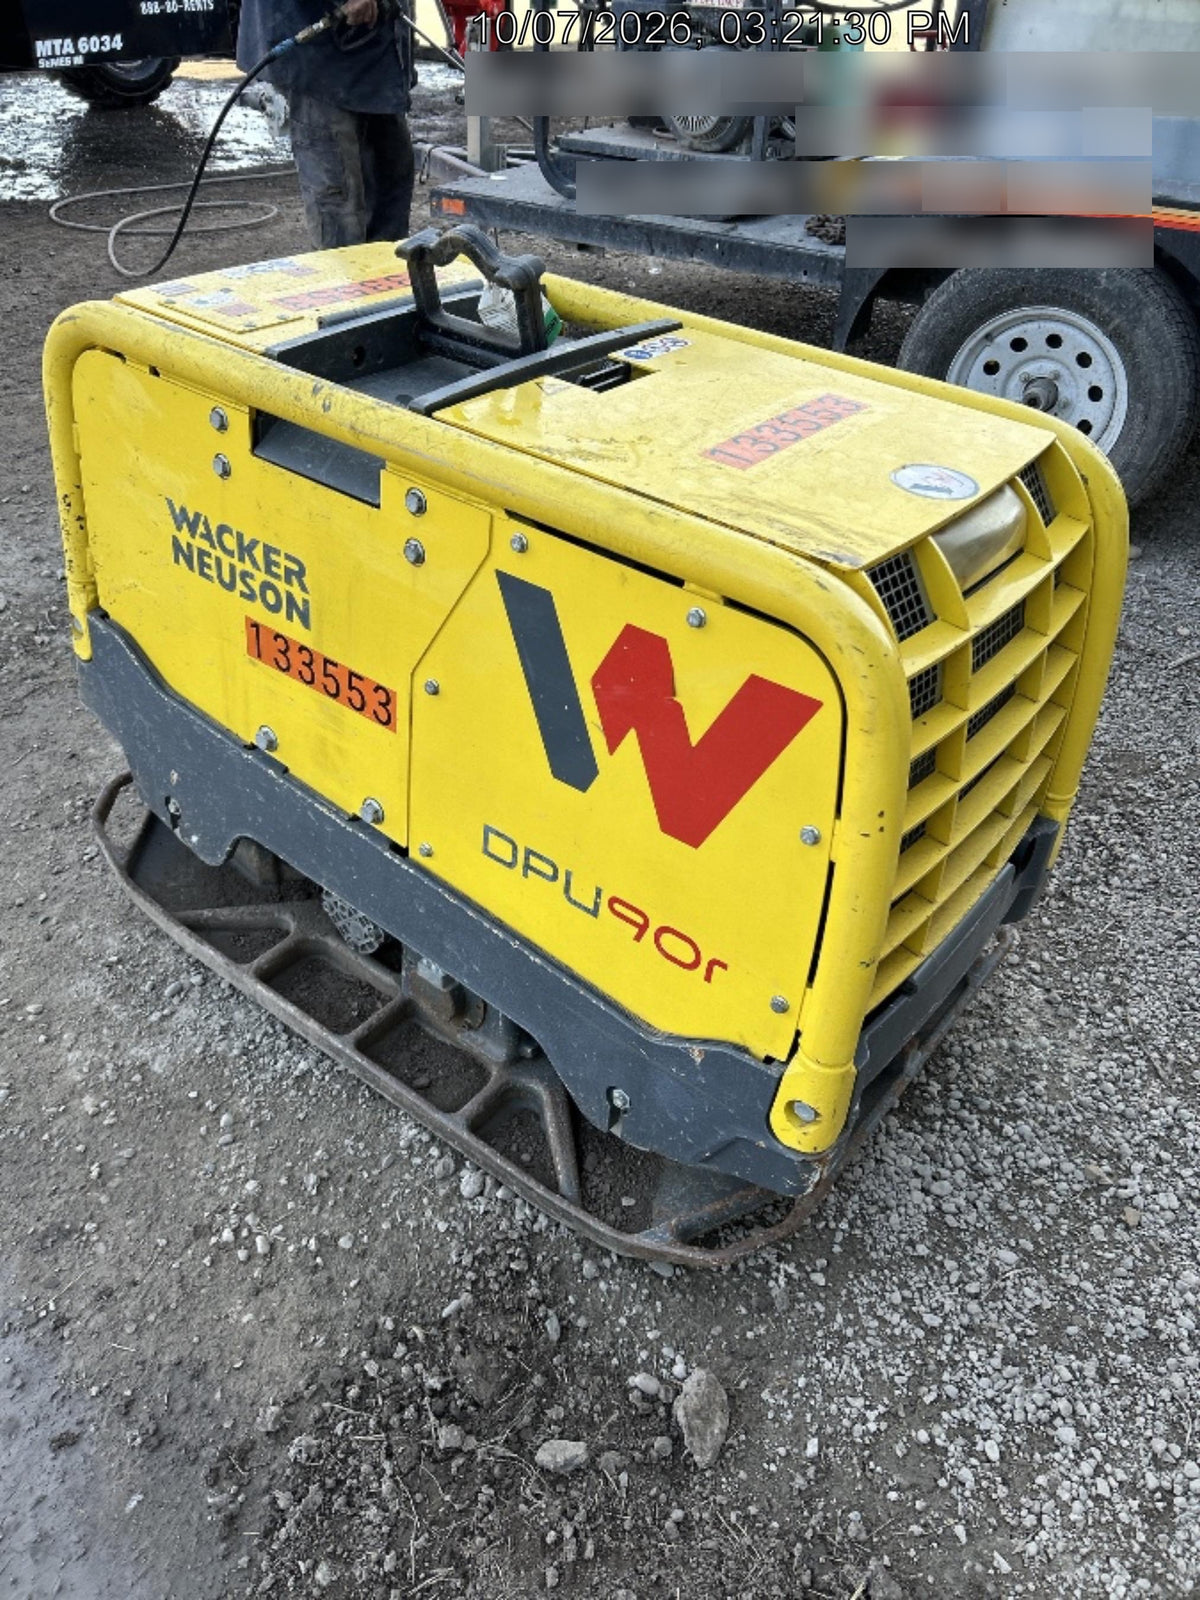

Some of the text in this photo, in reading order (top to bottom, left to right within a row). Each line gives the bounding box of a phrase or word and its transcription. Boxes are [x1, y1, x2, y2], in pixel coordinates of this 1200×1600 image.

[35, 33, 123, 57] MTA 6034
[710, 394, 861, 464] 133553
[165, 496, 309, 594] WACKER
[172, 534, 311, 631] NEUSON
[250, 622, 394, 727] 133553
